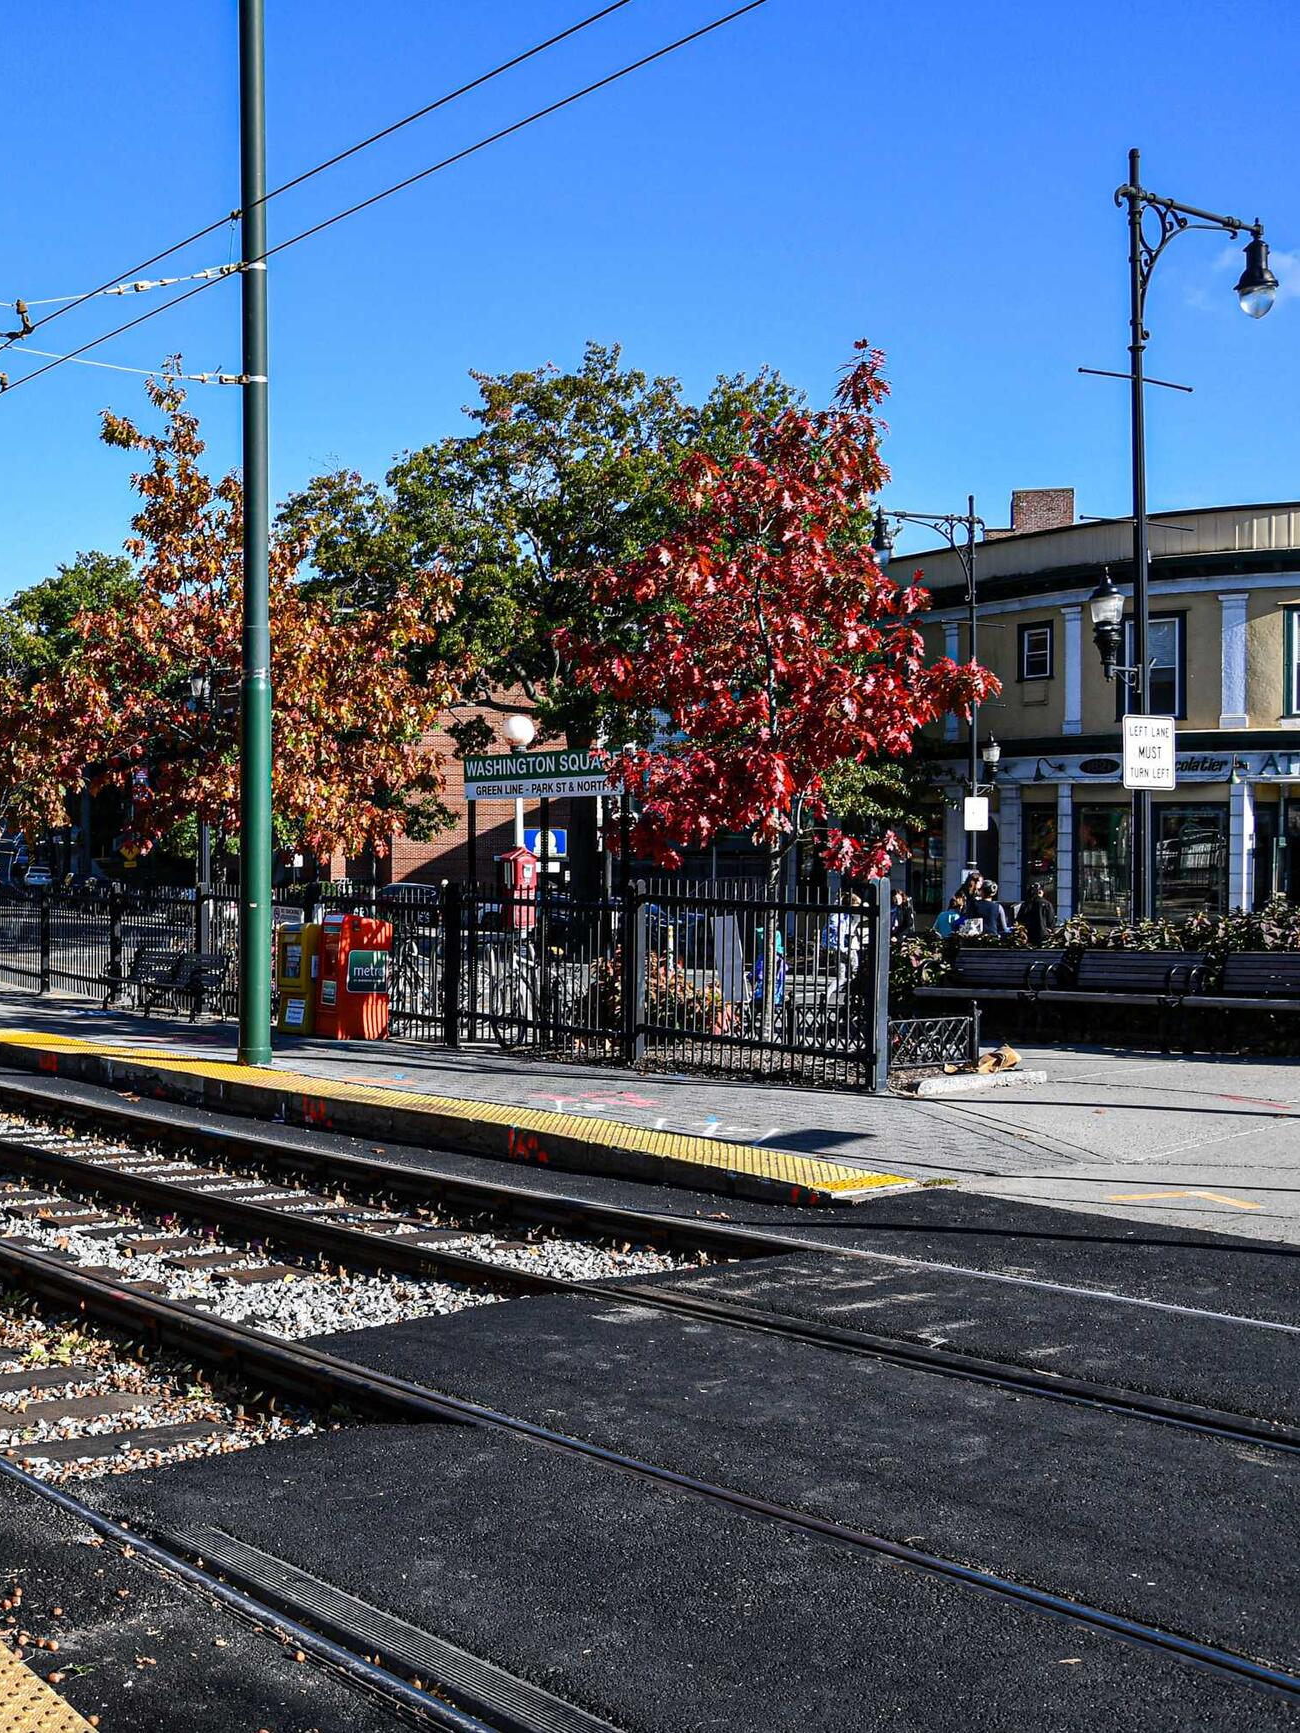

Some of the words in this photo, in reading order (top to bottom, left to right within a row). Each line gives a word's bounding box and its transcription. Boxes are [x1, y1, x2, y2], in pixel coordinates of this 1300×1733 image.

[1129, 725, 1148, 737] LEFT
[1151, 727, 1170, 738] LANE
[1138, 746, 1162, 759] MUST
[466, 755, 555, 777] WASHINGTON
[559, 751, 621, 772] SQUA
[1130, 767, 1149, 778] TURN
[1152, 768, 1170, 779] LEFT
[476, 784, 503, 796] GREEN
[504, 783, 524, 795] LINE
[531, 782, 553, 793] PARK
[555, 782, 567, 793] ST
[568, 781, 575, 792] &
[353, 963, 385, 977] metro
